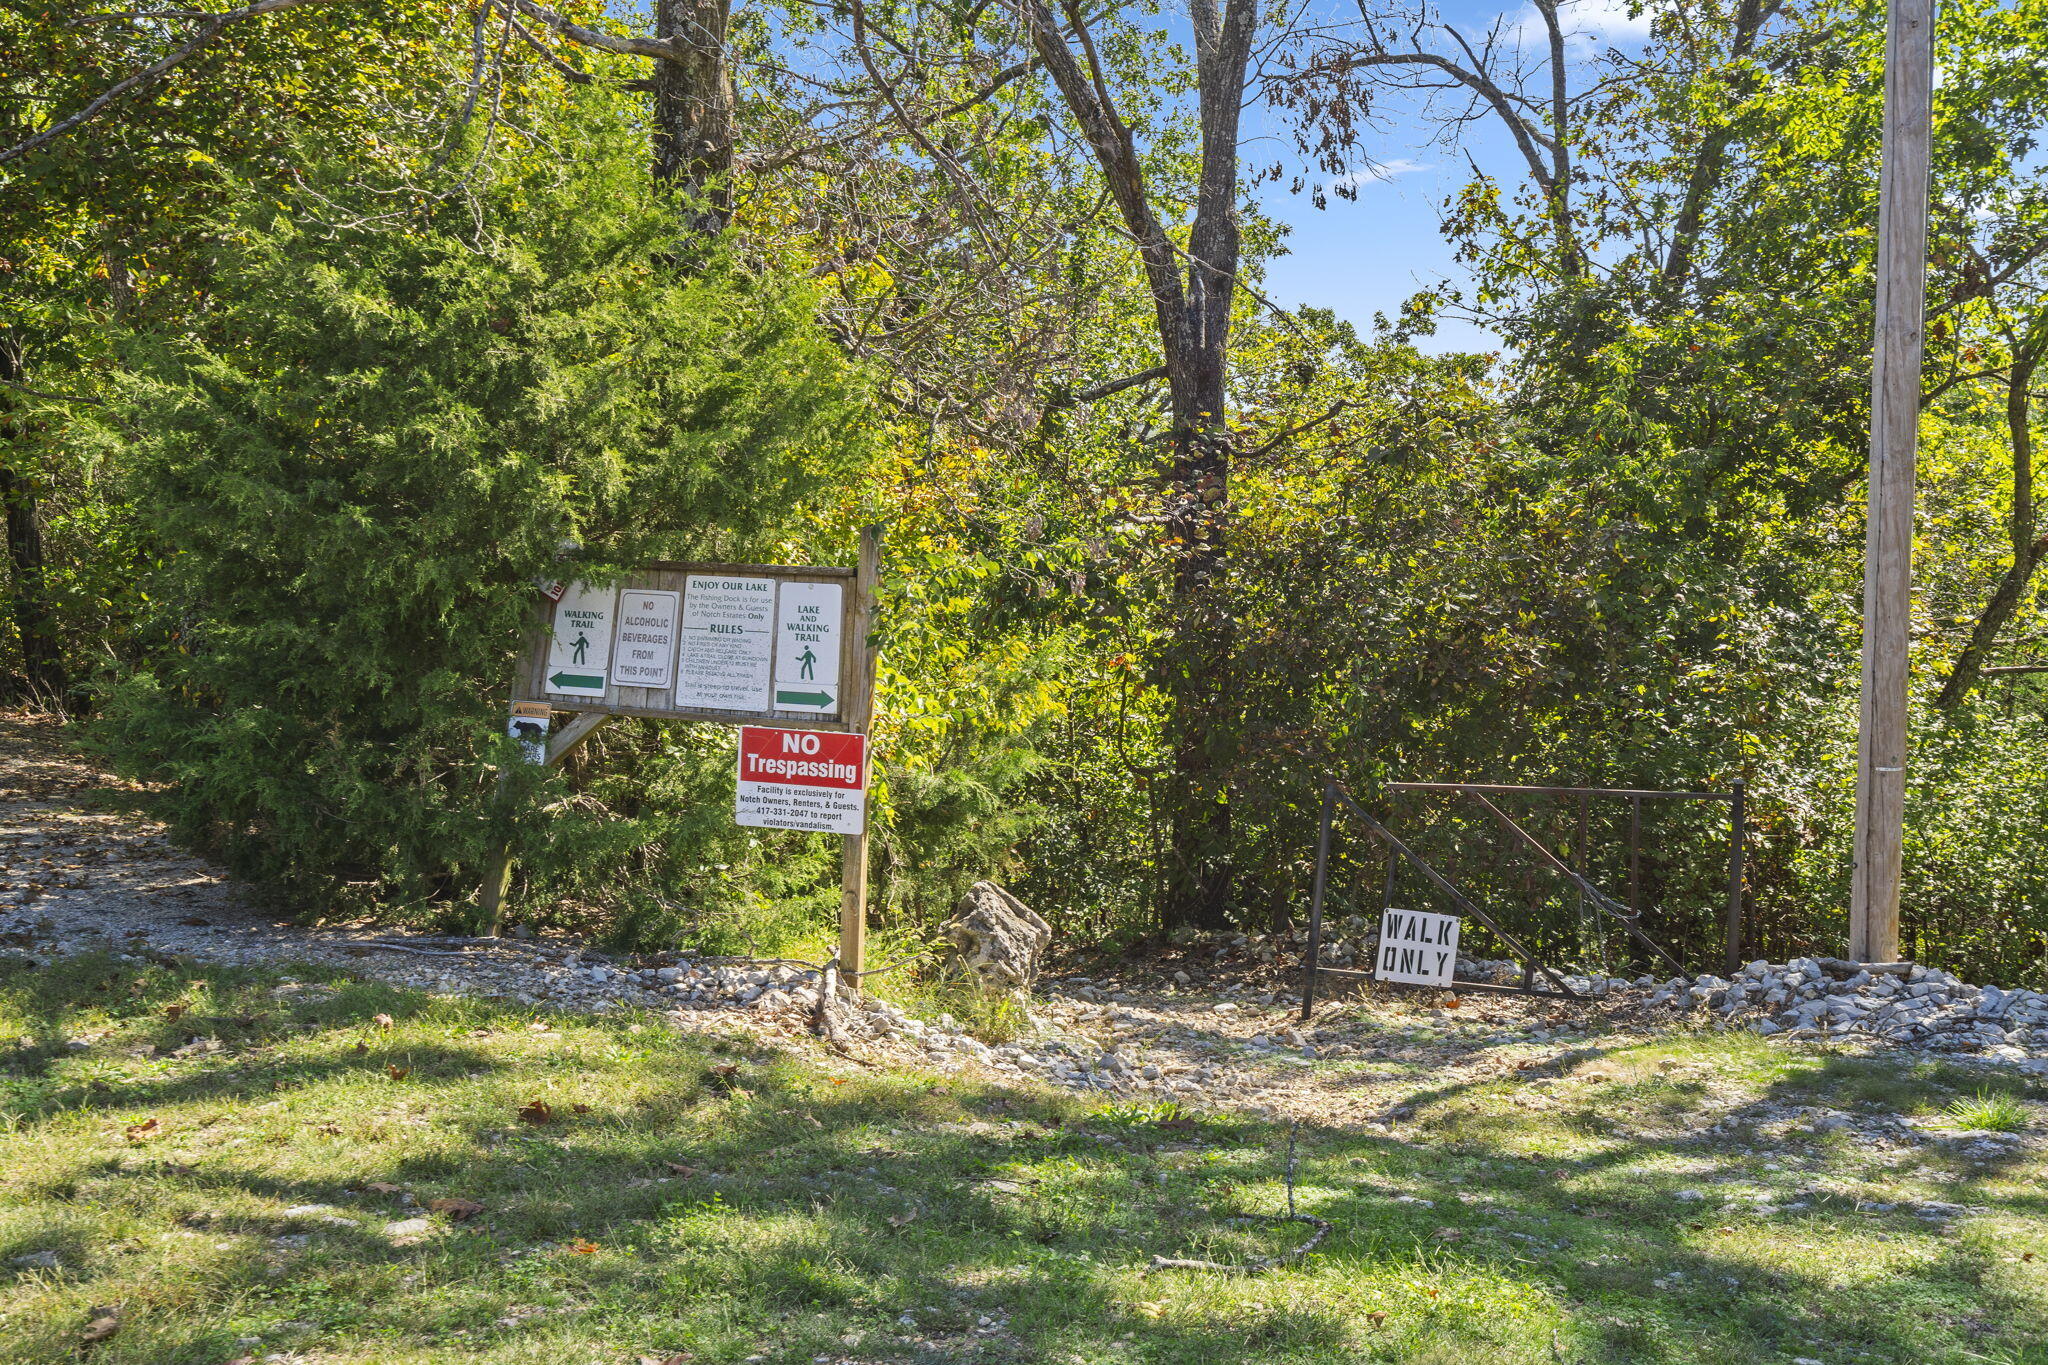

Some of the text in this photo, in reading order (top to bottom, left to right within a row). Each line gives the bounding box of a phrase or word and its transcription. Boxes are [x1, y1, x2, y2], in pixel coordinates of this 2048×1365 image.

[692, 581, 768, 592] ENJOY OUR LAKE
[701, 594, 722, 603] Fishing
[643, 601, 654, 610] NO
[798, 605, 820, 614] LAKE
[564, 610, 604, 620] WALKING
[748, 613, 765, 622] Only
[570, 620, 594, 629] TRAIL
[625, 617, 669, 628] ALCOHOLIC
[787, 623, 830, 633] WALKING
[710, 624, 743, 634] RULES
[622, 633, 668, 644] BEVERAGES
[795, 633, 820, 642] TRAIL
[632, 650, 654, 660] FROM
[620, 666, 664, 677] THIS POINT
[523, 707, 548, 716] WARNING
[782, 733, 820, 755] NO
[747, 753, 857, 784] Trespassing
[757, 785, 845, 799] Facility is exclusively for
[740, 795, 859, 811] Notch Owners, Renters, & Guests.
[756, 807, 808, 818] 417-331-2047
[820, 812, 842, 820] report
[763, 818, 834, 831] violators/vandalism.
[1387, 913, 1453, 946] WALK
[1382, 946, 1449, 977] ONLY
